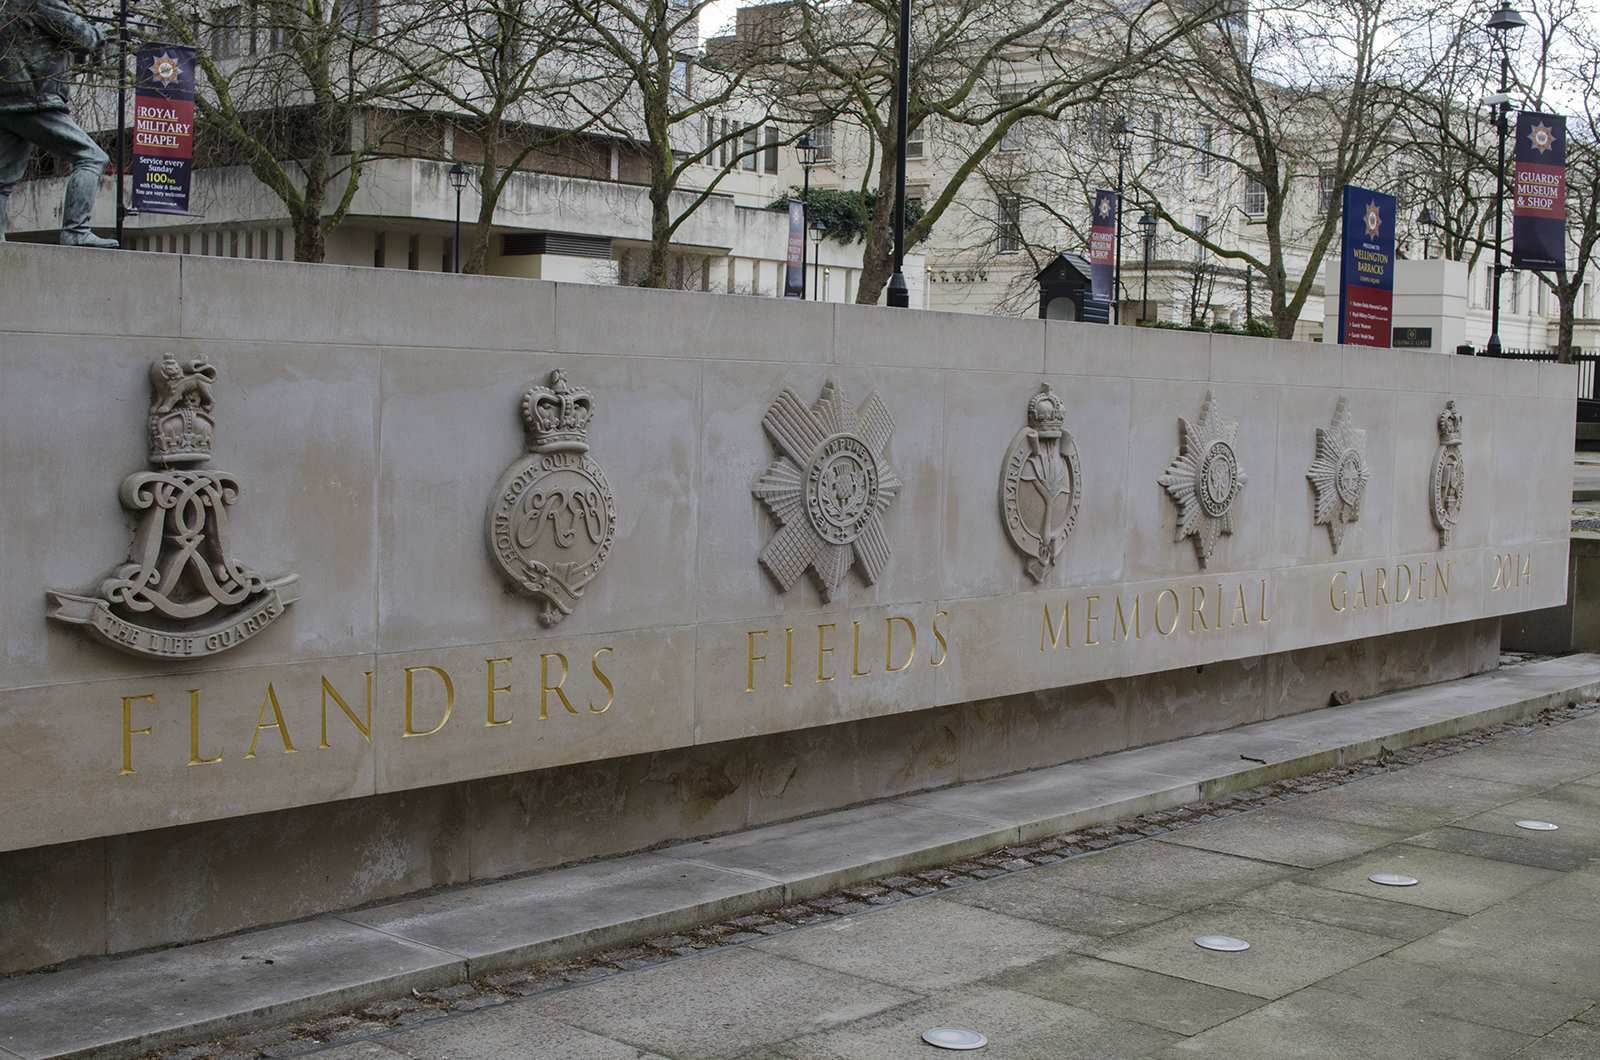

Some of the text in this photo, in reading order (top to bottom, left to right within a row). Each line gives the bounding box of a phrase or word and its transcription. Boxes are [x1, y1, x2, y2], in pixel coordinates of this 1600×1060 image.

[141, 106, 178, 120] ROYAL
[137, 120, 190, 134] MILITARY
[136, 133, 180, 146] CHAPEL
[140, 156, 184, 168] Service every
[148, 164, 174, 174] Sunday
[146, 172, 168, 183] 1100
[1520, 172, 1562, 184] GUARDS'
[1517, 184, 1558, 196] MUSEUM
[1516, 196, 1554, 208] & SHOP
[1091, 241, 1111, 250] MUSEUM
[1096, 250, 1108, 258] SHOP
[1353, 248, 1389, 264] WELLINGTON
[1358, 261, 1384, 275] BARRACKS
[825, 439, 867, 458] IMPUNE
[541, 453, 570, 472] QUI
[504, 466, 537, 505] SOIT
[496, 511, 518, 564] HONI
[103, 604, 277, 655] THE LIFE GUARDS
[118, 553, 1532, 776] FLANDERS FIELDS MEMORIAL GARDEN 2014
